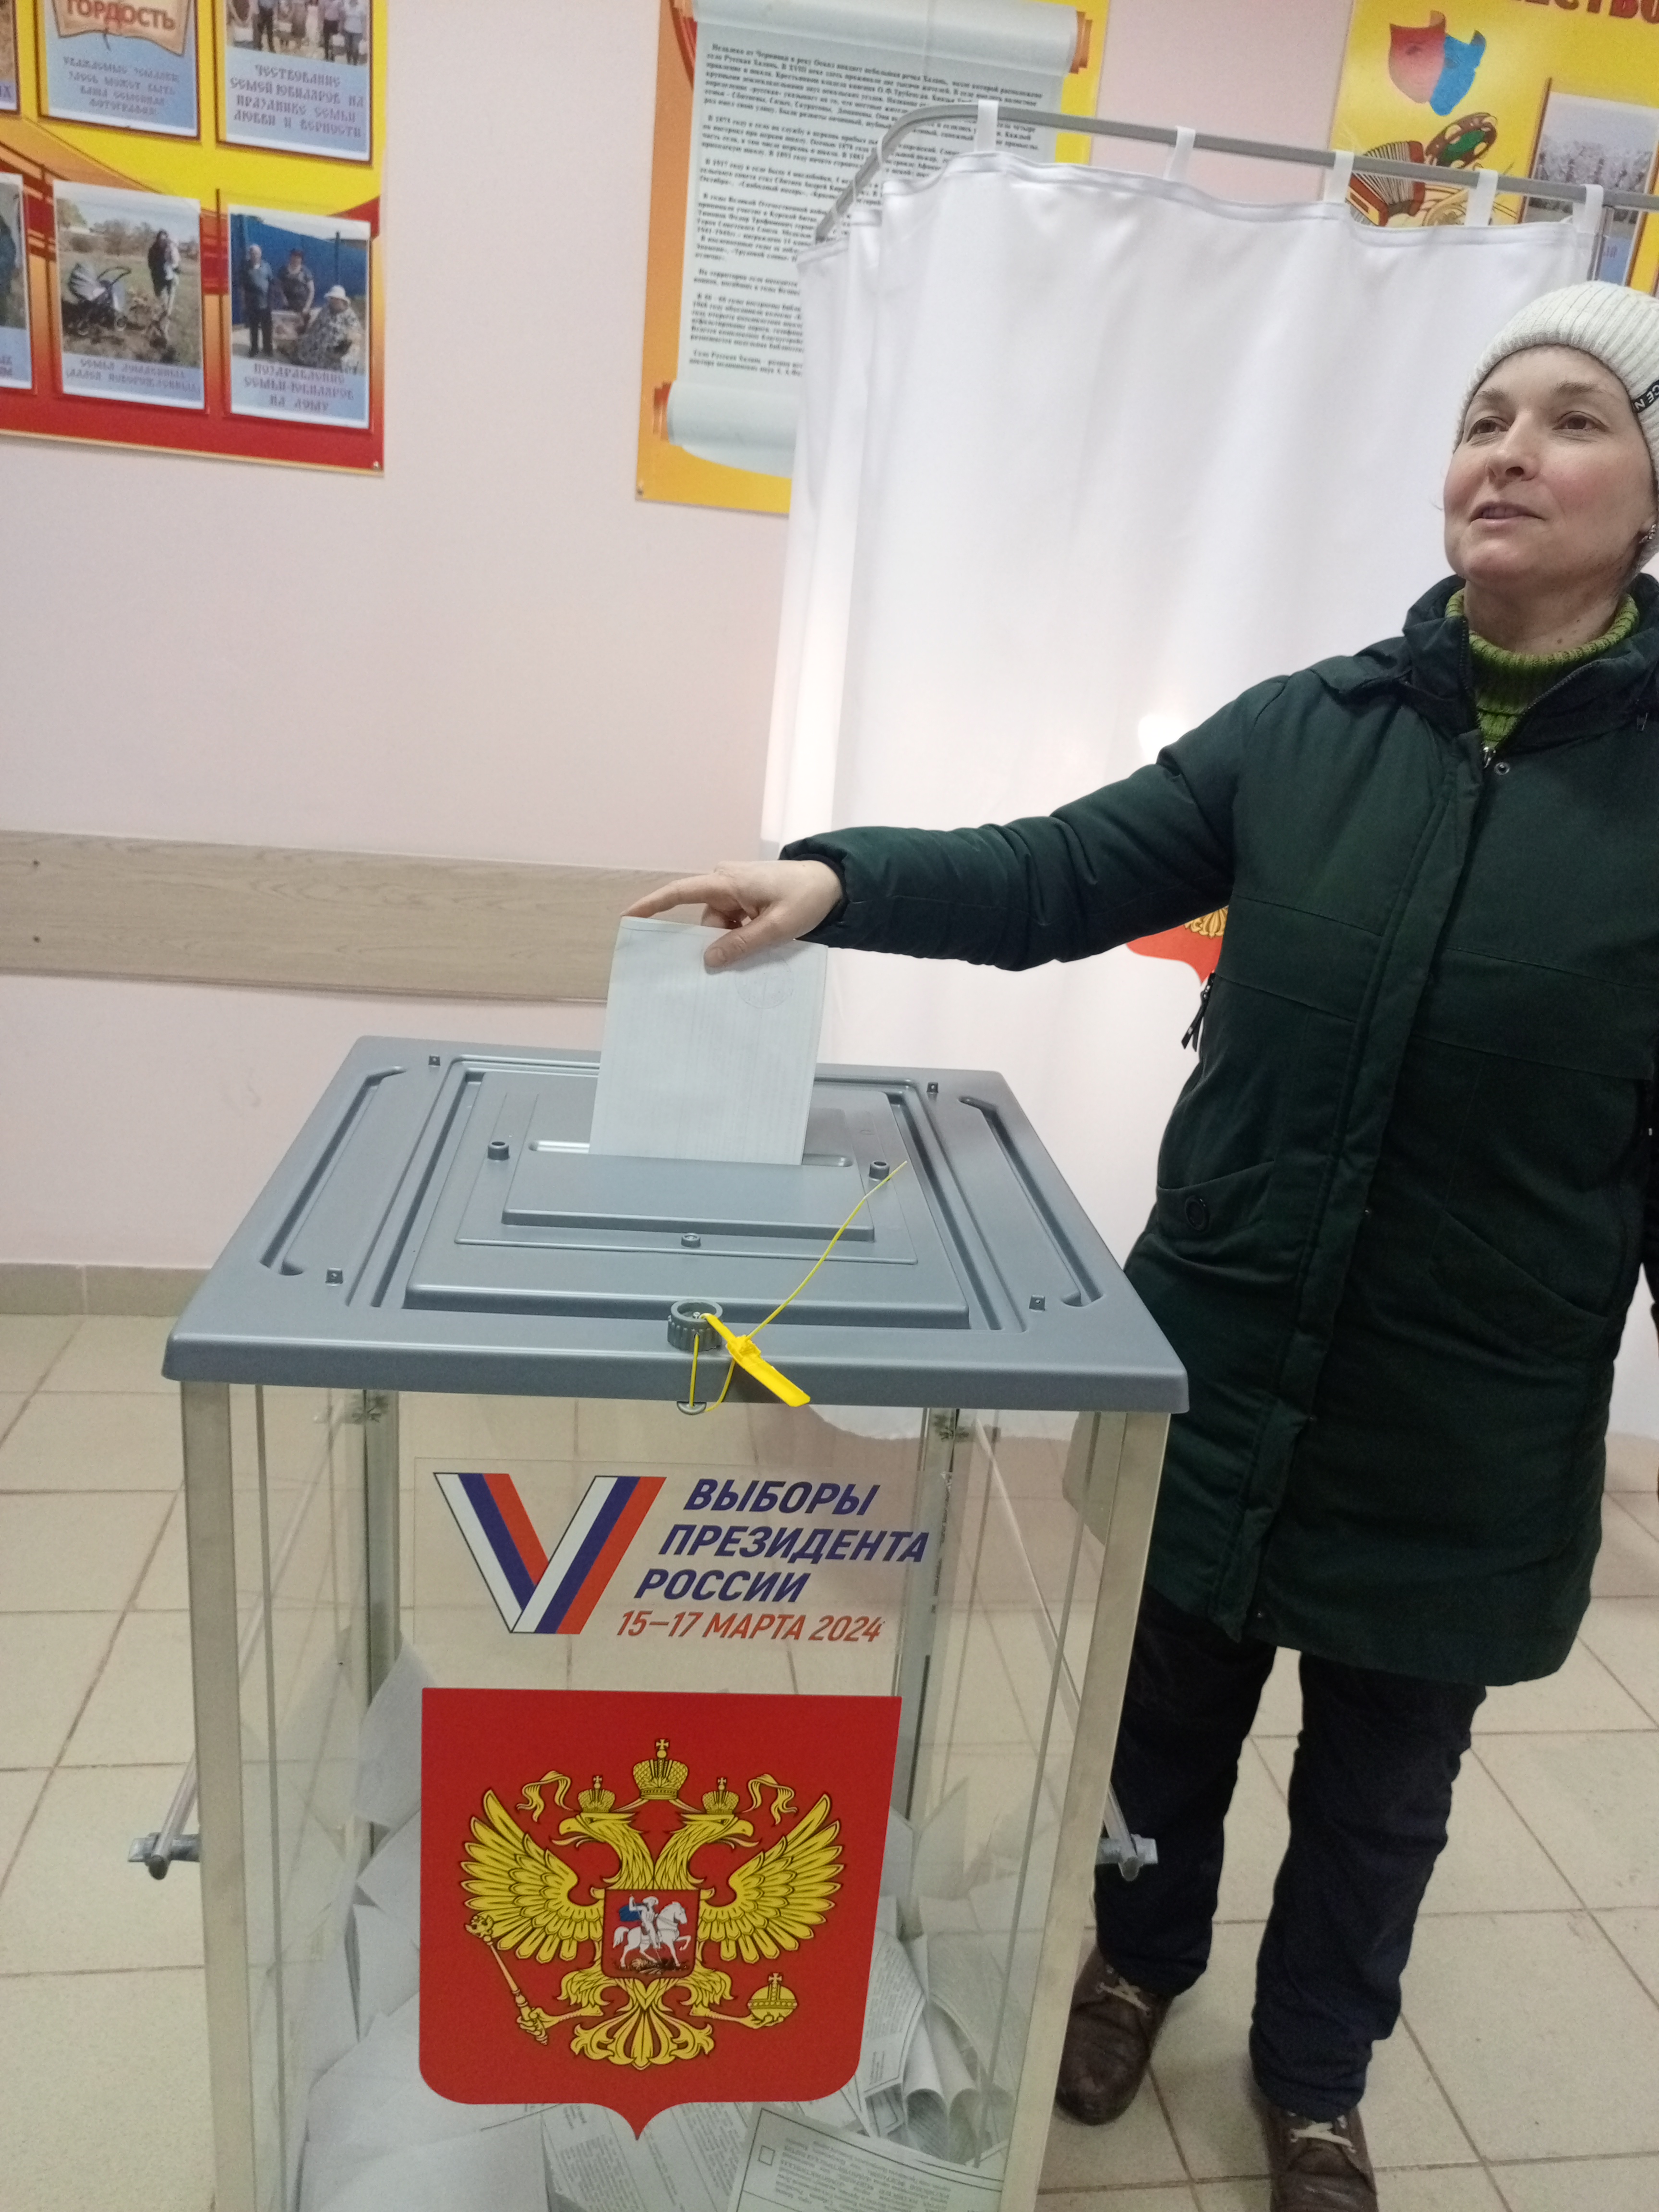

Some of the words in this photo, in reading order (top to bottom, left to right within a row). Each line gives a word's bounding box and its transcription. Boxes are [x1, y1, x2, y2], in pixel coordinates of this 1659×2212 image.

[349, 96, 363, 107] НА
[684, 1478, 880, 1516] ВЫБОРЫ
[658, 1524, 929, 1565] ПРЕЗИДЕНТА
[634, 1568, 810, 1603] РОССИИ
[702, 1612, 805, 1641] МАРТА
[808, 1615, 884, 1642] 2024
